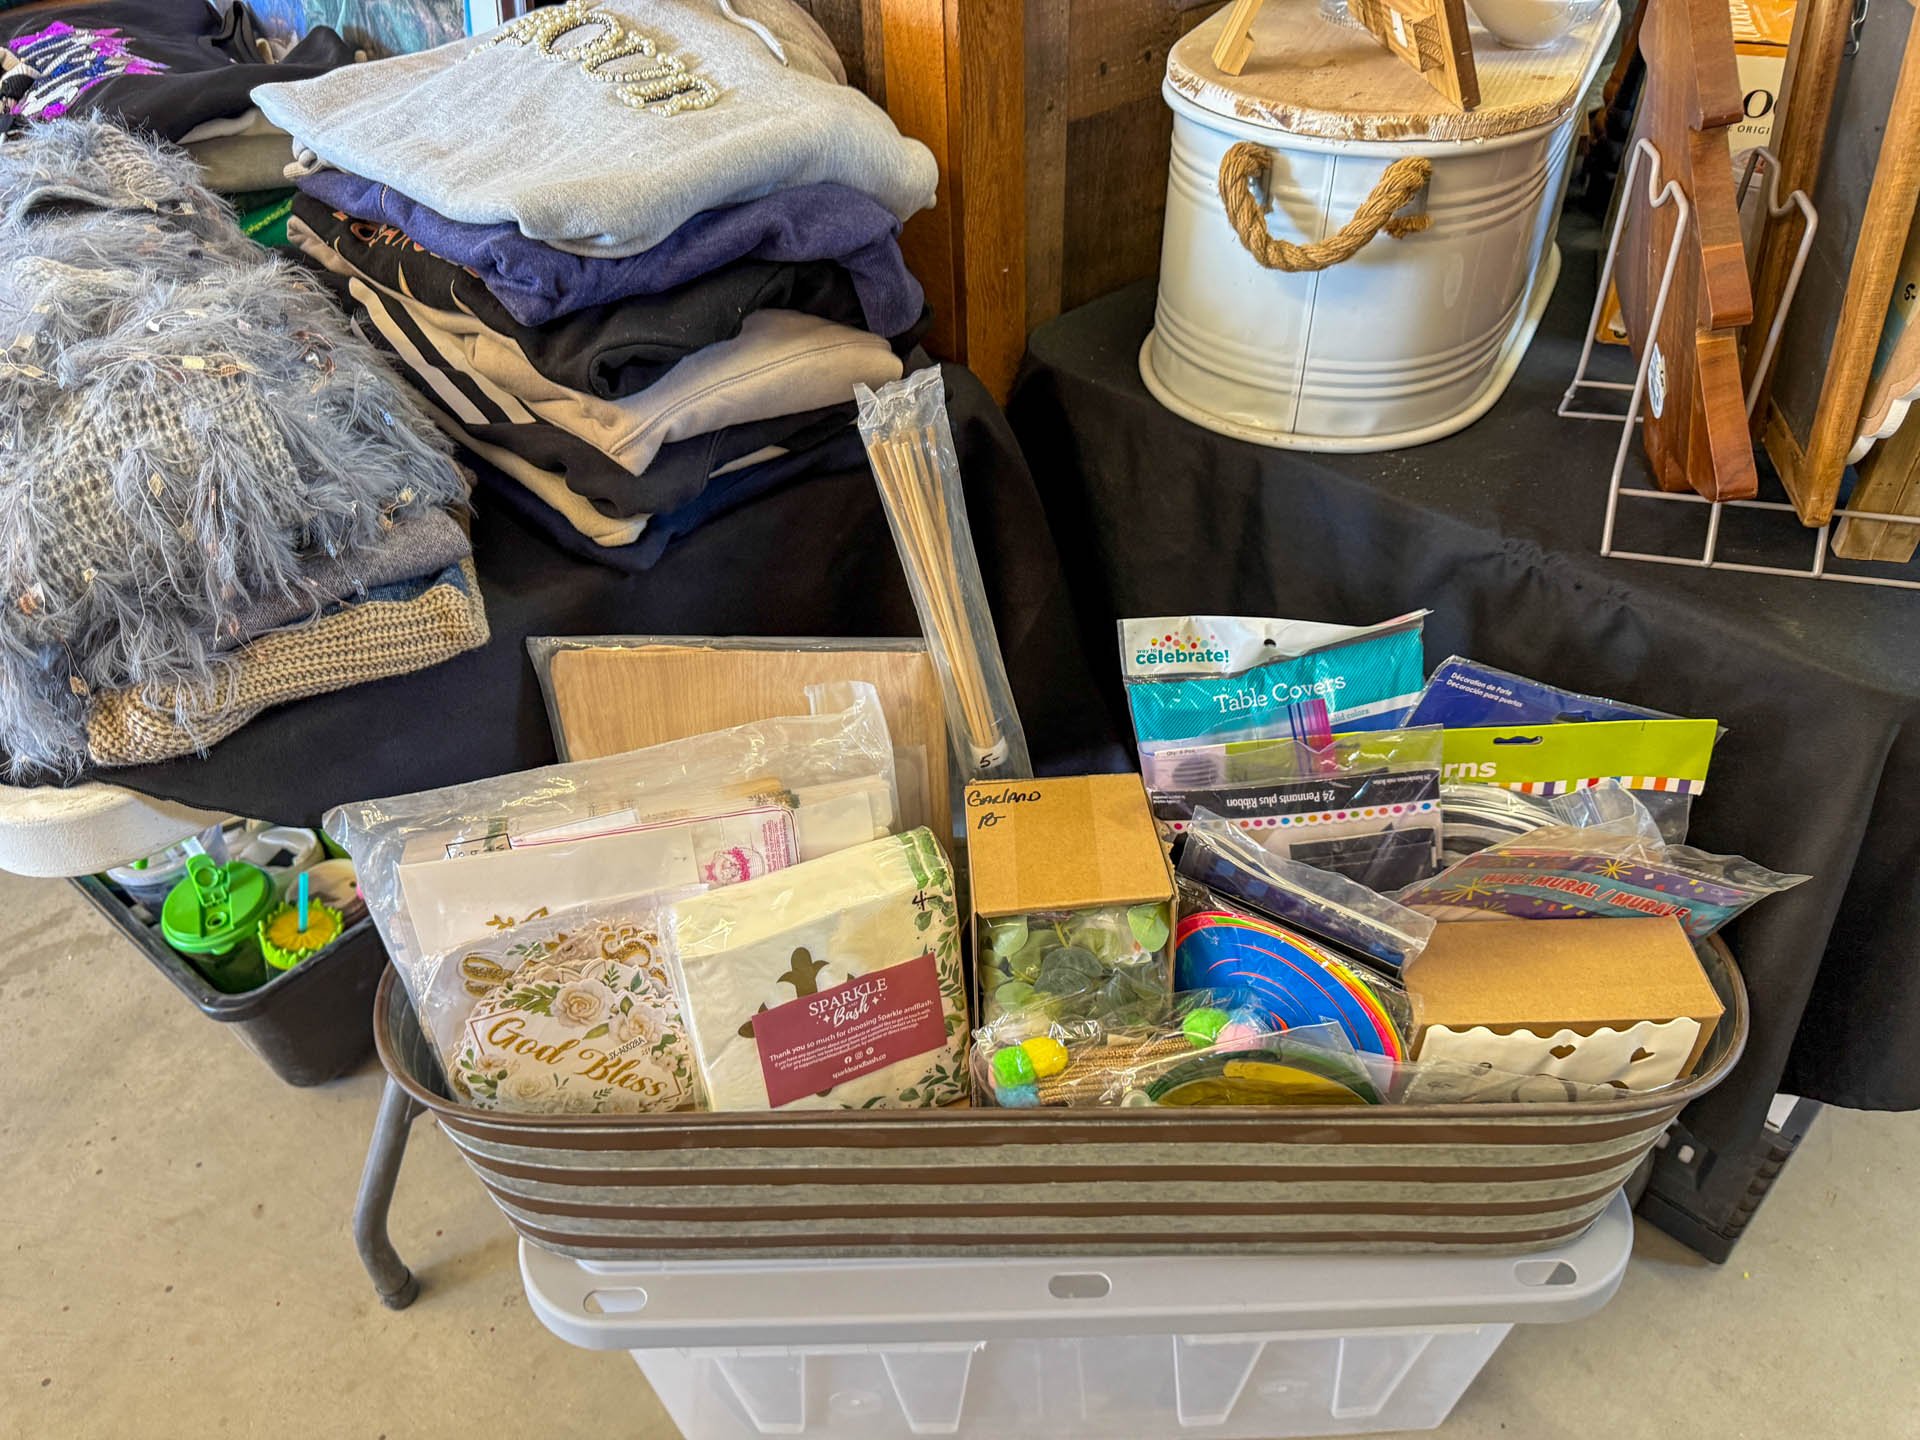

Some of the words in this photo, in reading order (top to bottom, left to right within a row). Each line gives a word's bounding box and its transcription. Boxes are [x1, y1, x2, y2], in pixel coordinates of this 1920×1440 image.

[1136, 649, 1229, 665] celebrate!
[1213, 688, 1269, 714] Table
[1272, 675, 1347, 702] Covers
[1443, 762, 1497, 778] rns
[1226, 798, 1258, 810] Ribbon
[1259, 796, 1278, 809] plus
[1279, 790, 1320, 805] Pennants
[1322, 790, 1335, 801] 24
[1529, 874, 1597, 899] MURAL
[809, 978, 888, 1017] SPARKLE
[833, 993, 869, 1028] Bash
[769, 1048, 791, 1062] Thank
[791, 1044, 806, 1055] you
[816, 1034, 836, 1046] much
[836, 1030, 846, 1038] for
[847, 1017, 877, 1034] choosing
[877, 1009, 903, 1022] Sparkle
[487, 1017, 580, 1065] God
[573, 1048, 667, 1096] Bless
